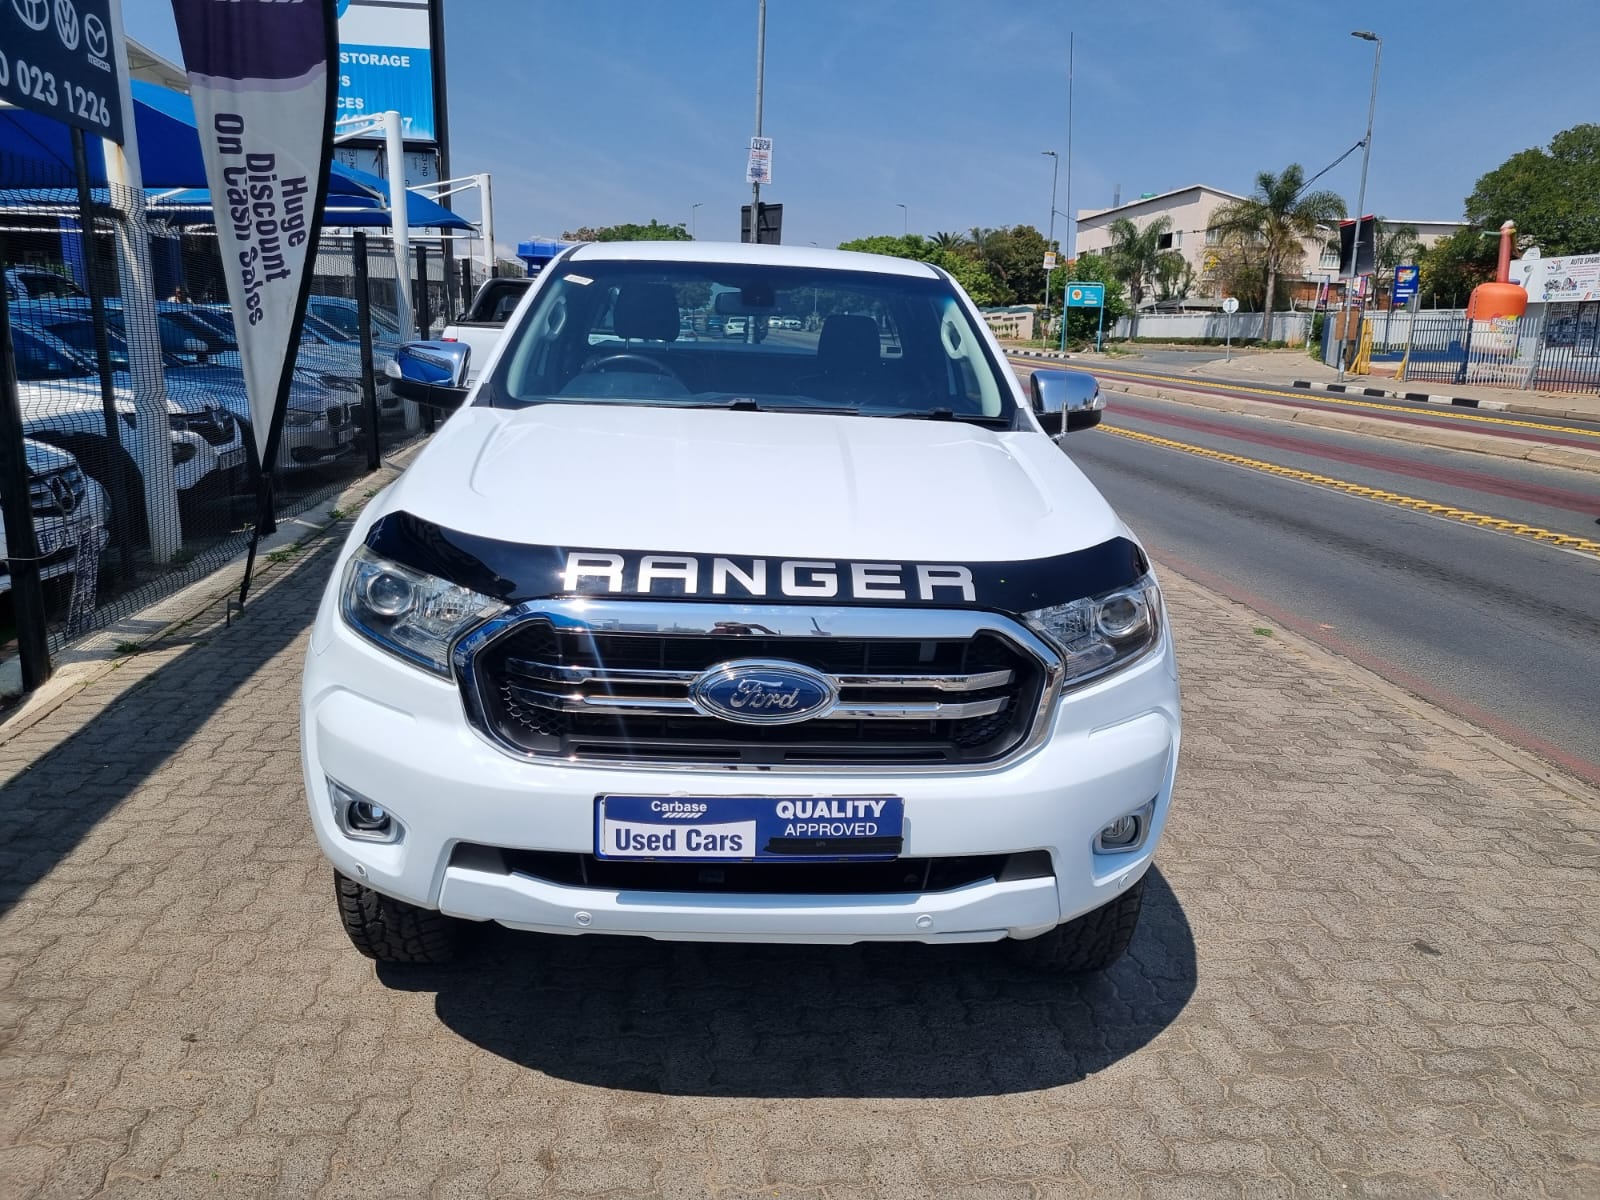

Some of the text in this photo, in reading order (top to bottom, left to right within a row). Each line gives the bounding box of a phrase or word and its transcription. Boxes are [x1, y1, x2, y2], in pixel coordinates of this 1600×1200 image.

[339, 52, 411, 67] STORAGE
[17, 60, 58, 106] 023
[64, 81, 110, 127] 1226
[215, 113, 245, 155] On
[246, 153, 291, 283] Discount
[281, 175, 308, 248] Huge
[562, 552, 976, 601] RANGER
[730, 679, 800, 709] Ford
[651, 800, 708, 813] Carbase
[776, 800, 887, 820] QUALITY
[615, 829, 743, 852] Used Cars
[784, 823, 878, 837] APPROVED
